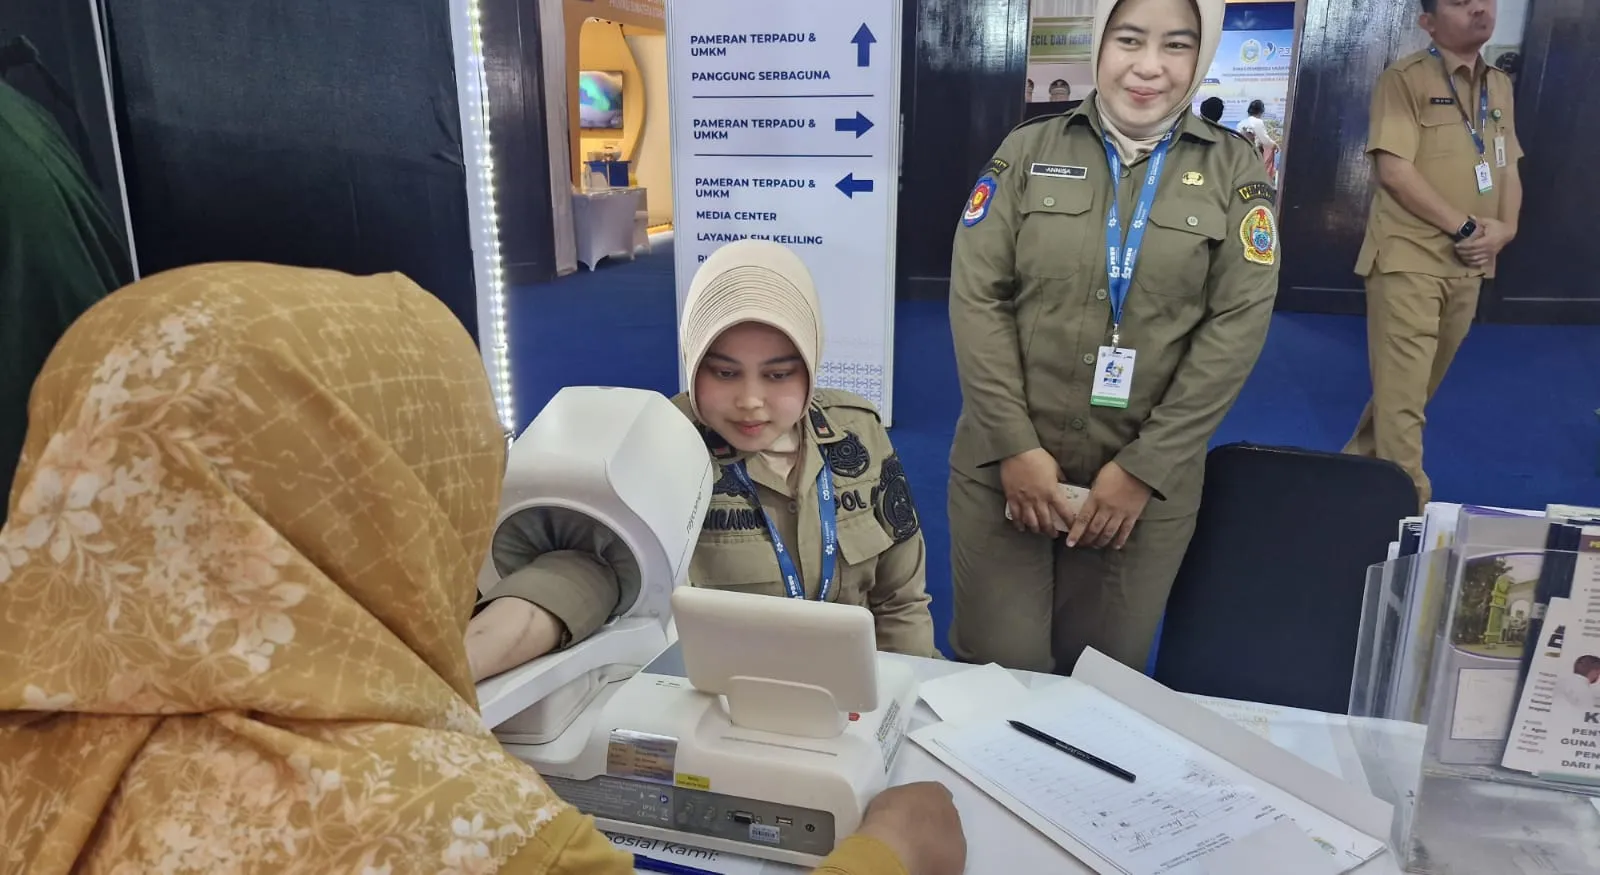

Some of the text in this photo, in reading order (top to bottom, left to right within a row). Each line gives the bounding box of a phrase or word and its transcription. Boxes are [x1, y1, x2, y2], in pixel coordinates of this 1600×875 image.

[690, 33, 816, 44] PAMERAN TERPADU &
[691, 47, 727, 57] UMKM
[691, 70, 831, 81] PANGGUNG SERBAGUNA
[693, 119, 816, 128] PAMERAN TERPADU &
[693, 130, 728, 140] UMKM
[695, 177, 816, 188] PAMERAN TERPADU &
[695, 189, 730, 198] UMKM
[696, 211, 777, 221] MEDIA CENTER
[697, 232, 747, 242] LAYANAN
[773, 235, 823, 245] KELILING
[1560, 738, 1597, 748] GUNA
[1561, 760, 1591, 769] DARI
[604, 831, 720, 862] Sosial Kami:
